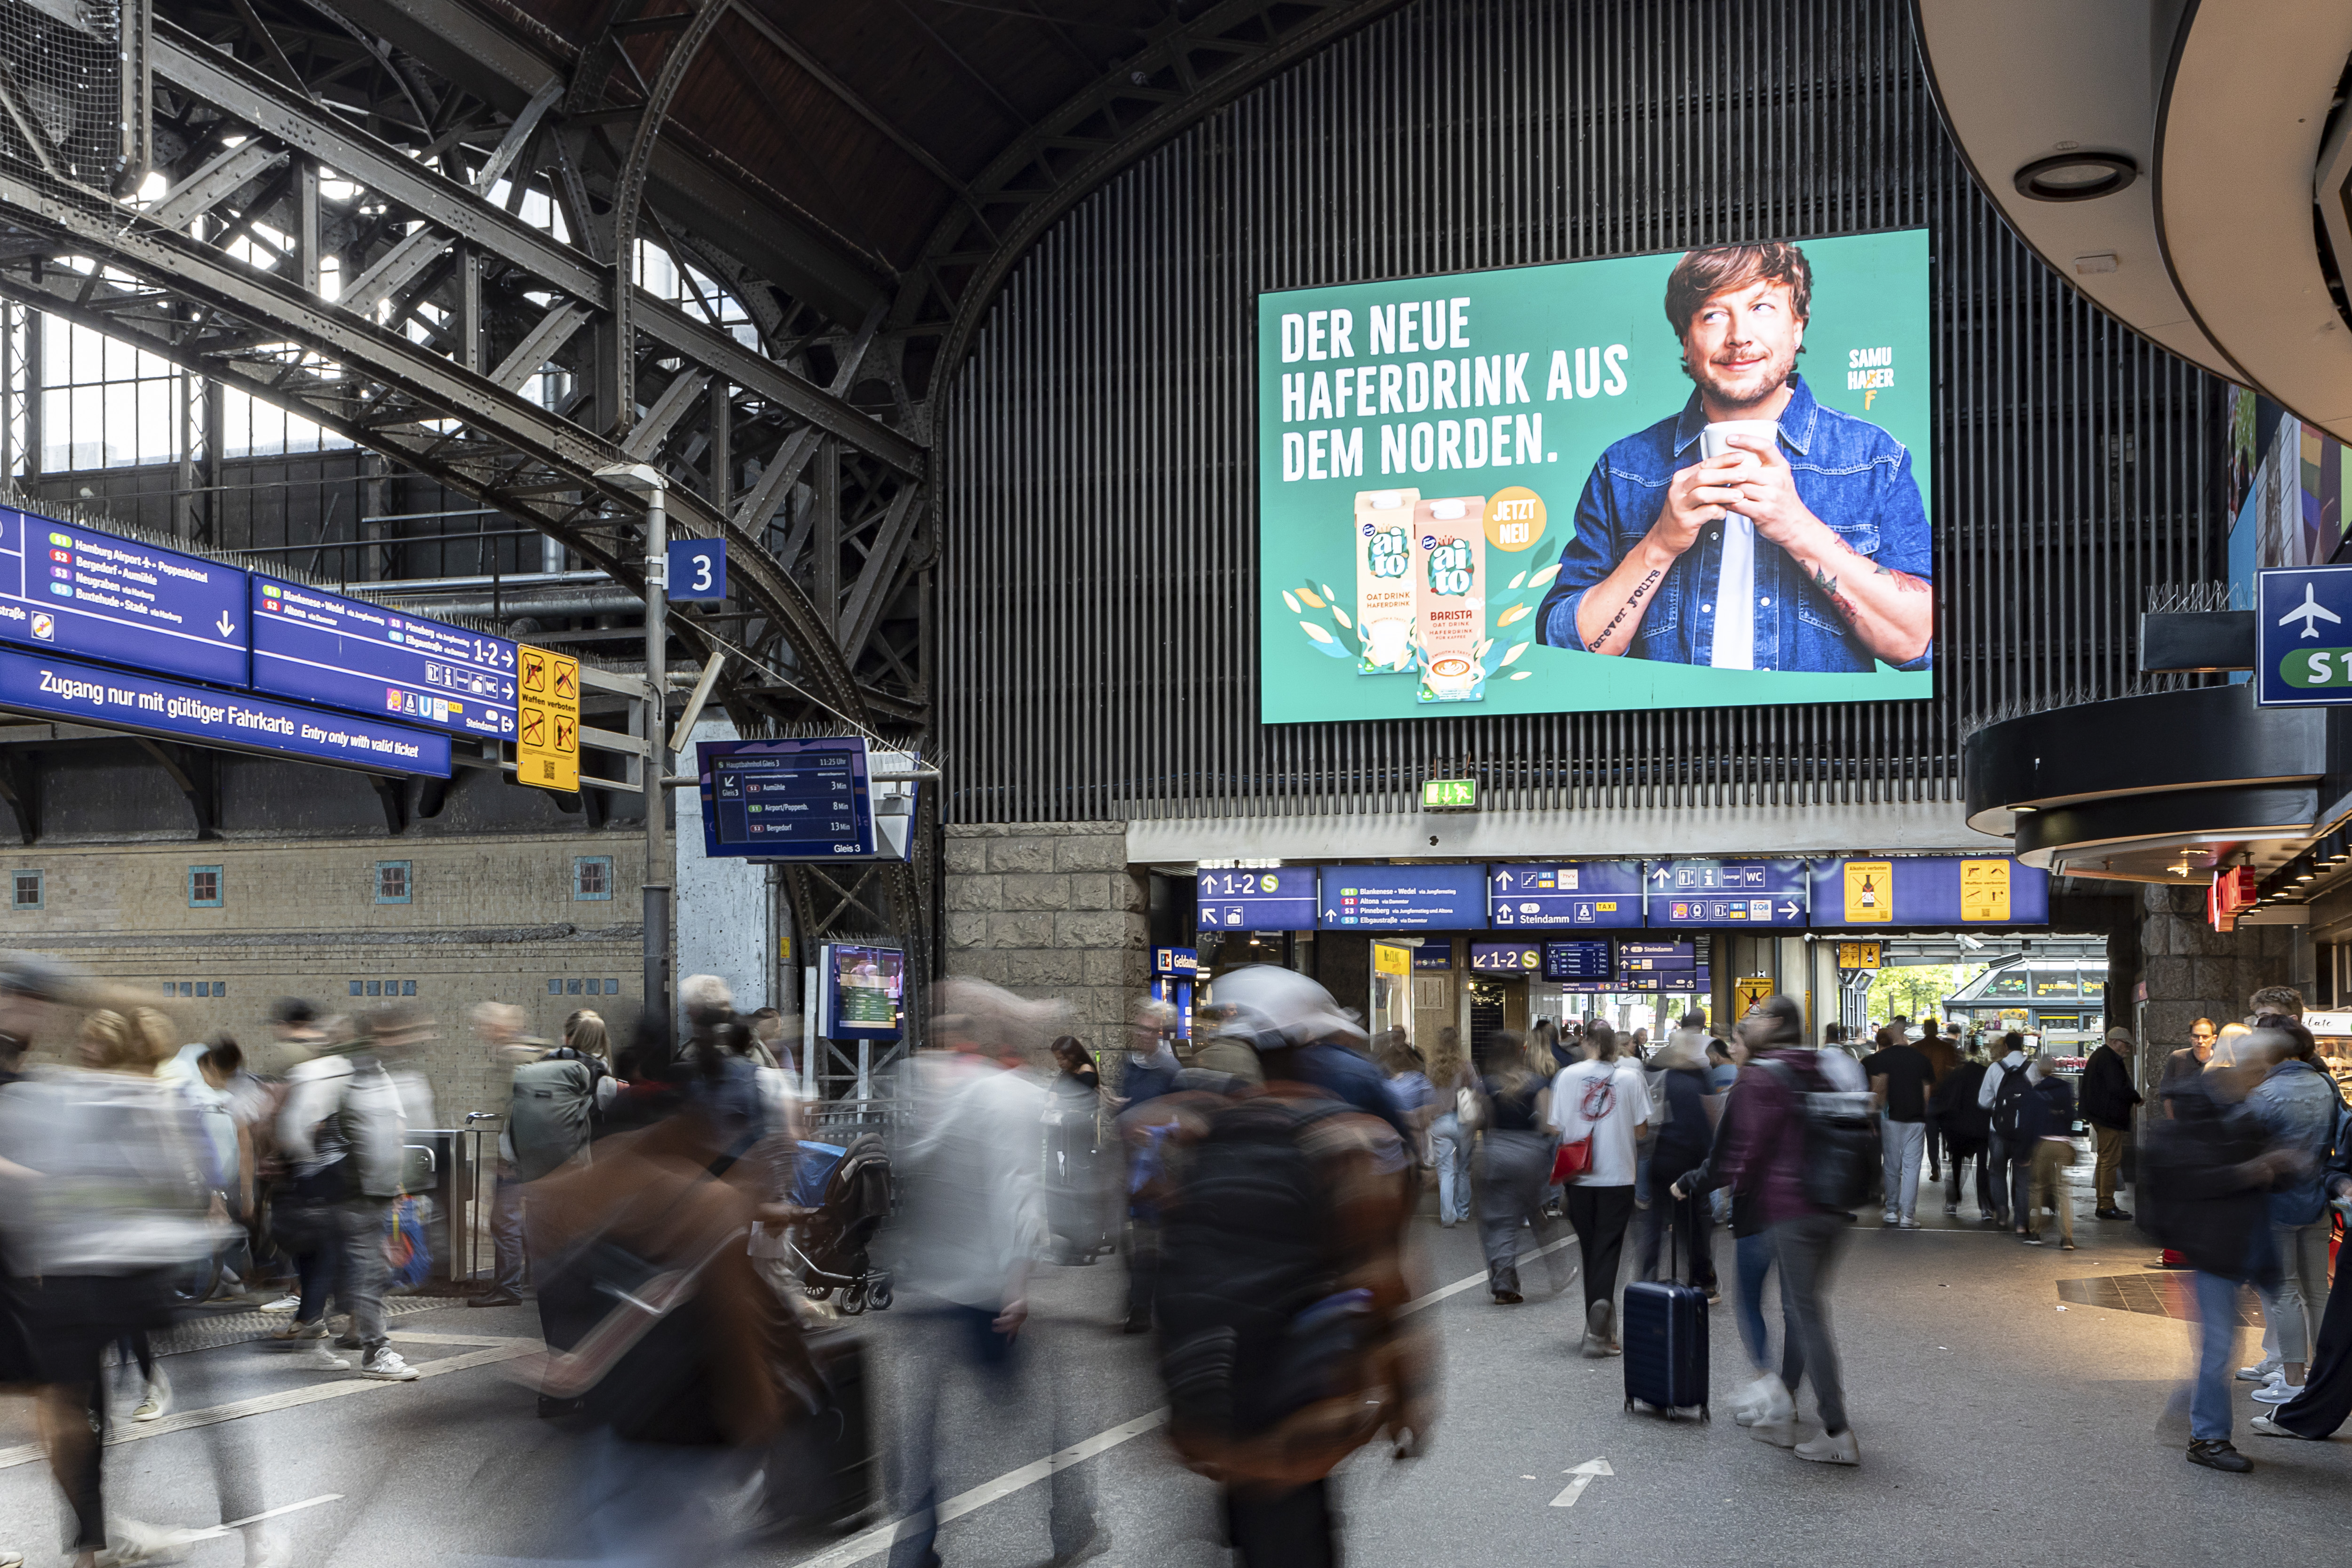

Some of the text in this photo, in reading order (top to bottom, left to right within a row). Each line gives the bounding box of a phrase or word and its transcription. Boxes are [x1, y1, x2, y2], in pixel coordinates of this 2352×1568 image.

[1281, 297, 1470, 363] DER NEUE
[1849, 346, 1892, 369] SAMU
[1282, 344, 1629, 423] HAFERDRINK AUS
[1282, 412, 1558, 482] DEM NORDEN.
[1492, 499, 1536, 521] JETZT
[1499, 523, 1529, 545] NEU
[55, 535, 208, 583] S1 Hamburg Airport Poppenbüttel
[55, 551, 158, 586] S2 Bergedorf Aumühle
[692, 554, 712, 591] 3
[55, 568, 155, 602] S3 Neugraben via Harburg
[55, 584, 182, 624] S5 Buxtehude Stade via Harburg
[267, 601, 278, 611] S2
[284, 604, 306, 618] Altona
[283, 590, 321, 609] Blankenese
[324, 601, 345, 615] Wedel
[1588, 570, 1661, 653] forever yours
[1430, 610, 1472, 620] BARISTA
[405, 621, 435, 639] Pinneberg
[405, 634, 443, 652] Elbgaustraße
[474, 639, 498, 666] 1-2
[1432, 650, 1451, 659] SMOOTH
[485, 681, 497, 693] WC
[522, 693, 576, 713] Waffen verboten
[40, 670, 419, 758] Zugang nur mit gültiger Fahrkarte Entry only with valid ticket
[466, 718, 498, 733] Steindamm
[831, 781, 836, 790] 3
[833, 802, 838, 810] 8
[767, 824, 792, 833] Bergedorf
[831, 822, 840, 831] 13
[834, 844, 854, 853] Gleis
[1224, 874, 1277, 894] 1-2 S
[1746, 872, 1762, 882] WC
[1360, 916, 1398, 925] Elbgaustraße
[1520, 914, 1569, 924] Steindamm
[1490, 951, 1518, 968] 1-2
[1524, 951, 1537, 968] S
